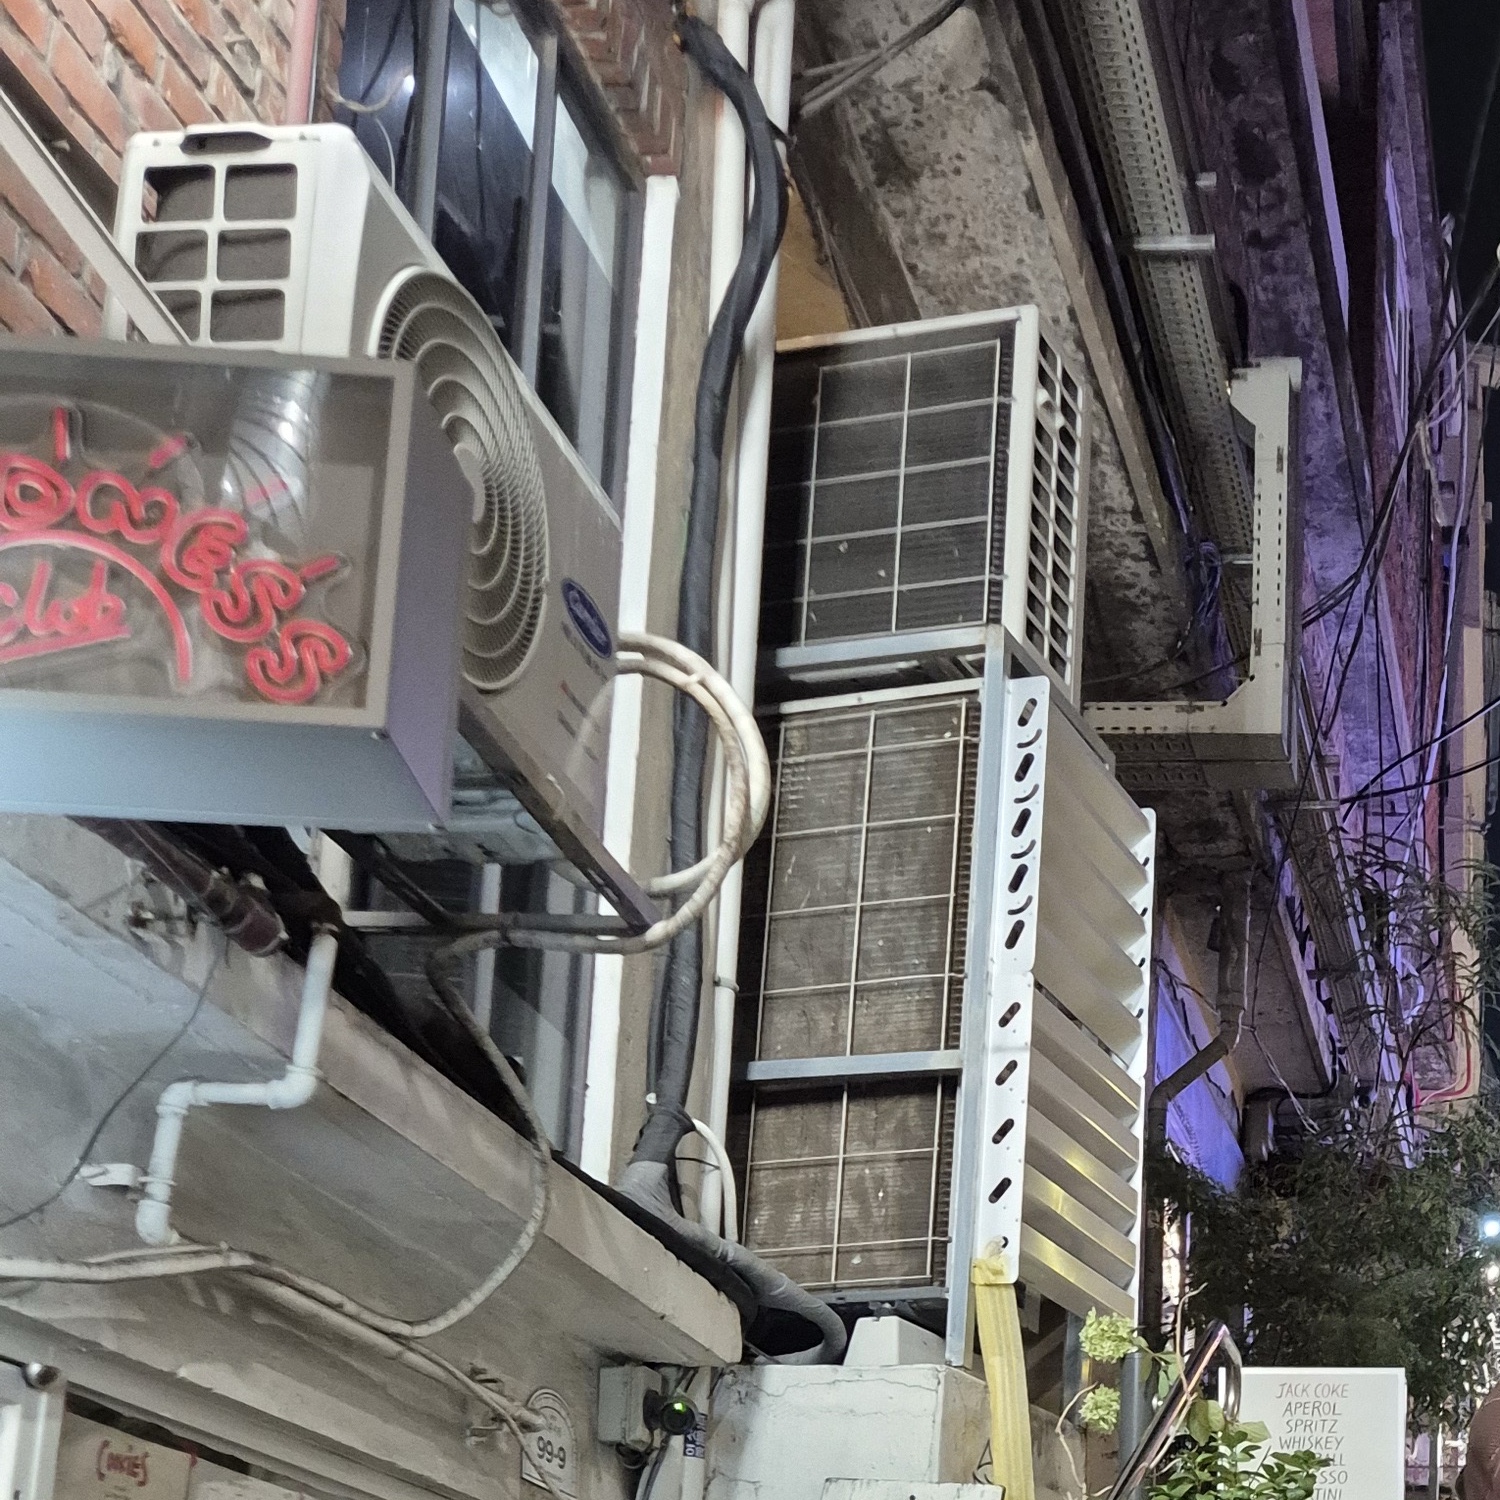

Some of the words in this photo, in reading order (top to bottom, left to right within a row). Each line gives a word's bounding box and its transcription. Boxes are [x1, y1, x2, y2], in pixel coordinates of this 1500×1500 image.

[1275, 1382, 1309, 1399] JACK
[1314, 1382, 1349, 1399] COKE
[1282, 1400, 1342, 1417] APEROL
[1285, 1418, 1338, 1434] SPRITZ
[1278, 1435, 1345, 1451] WHISKEY
[537, 1436, 566, 1470] 99-9
[1311, 1487, 1342, 1500] TINI
